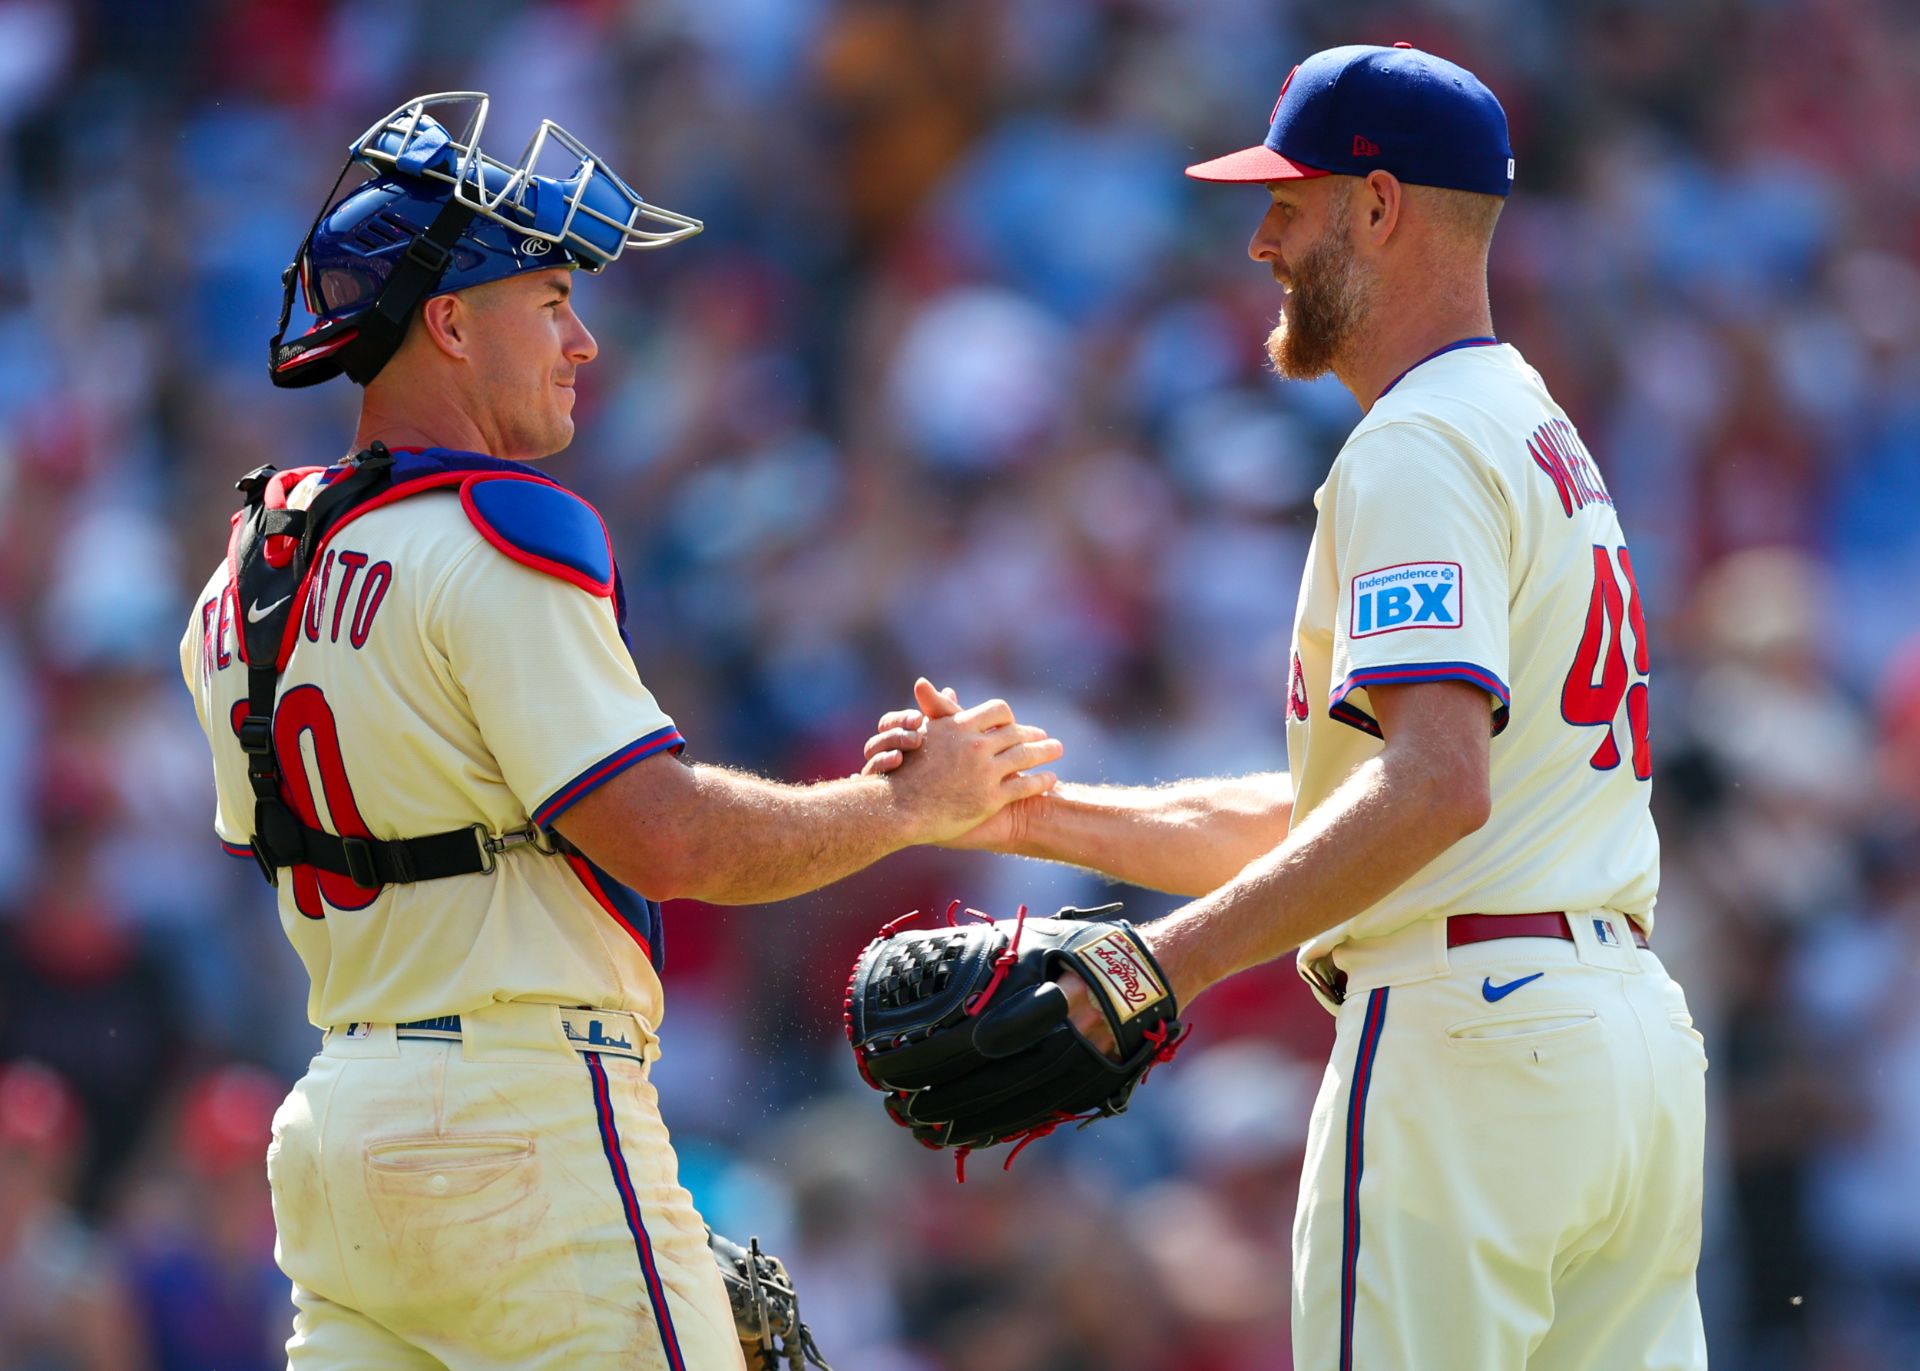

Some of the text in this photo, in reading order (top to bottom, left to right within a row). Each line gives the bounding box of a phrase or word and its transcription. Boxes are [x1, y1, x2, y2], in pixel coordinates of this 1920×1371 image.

[1358, 569, 1438, 590] Independence
[1358, 583, 1454, 632] IBX
[1095, 946, 1146, 1003] Rawlings
